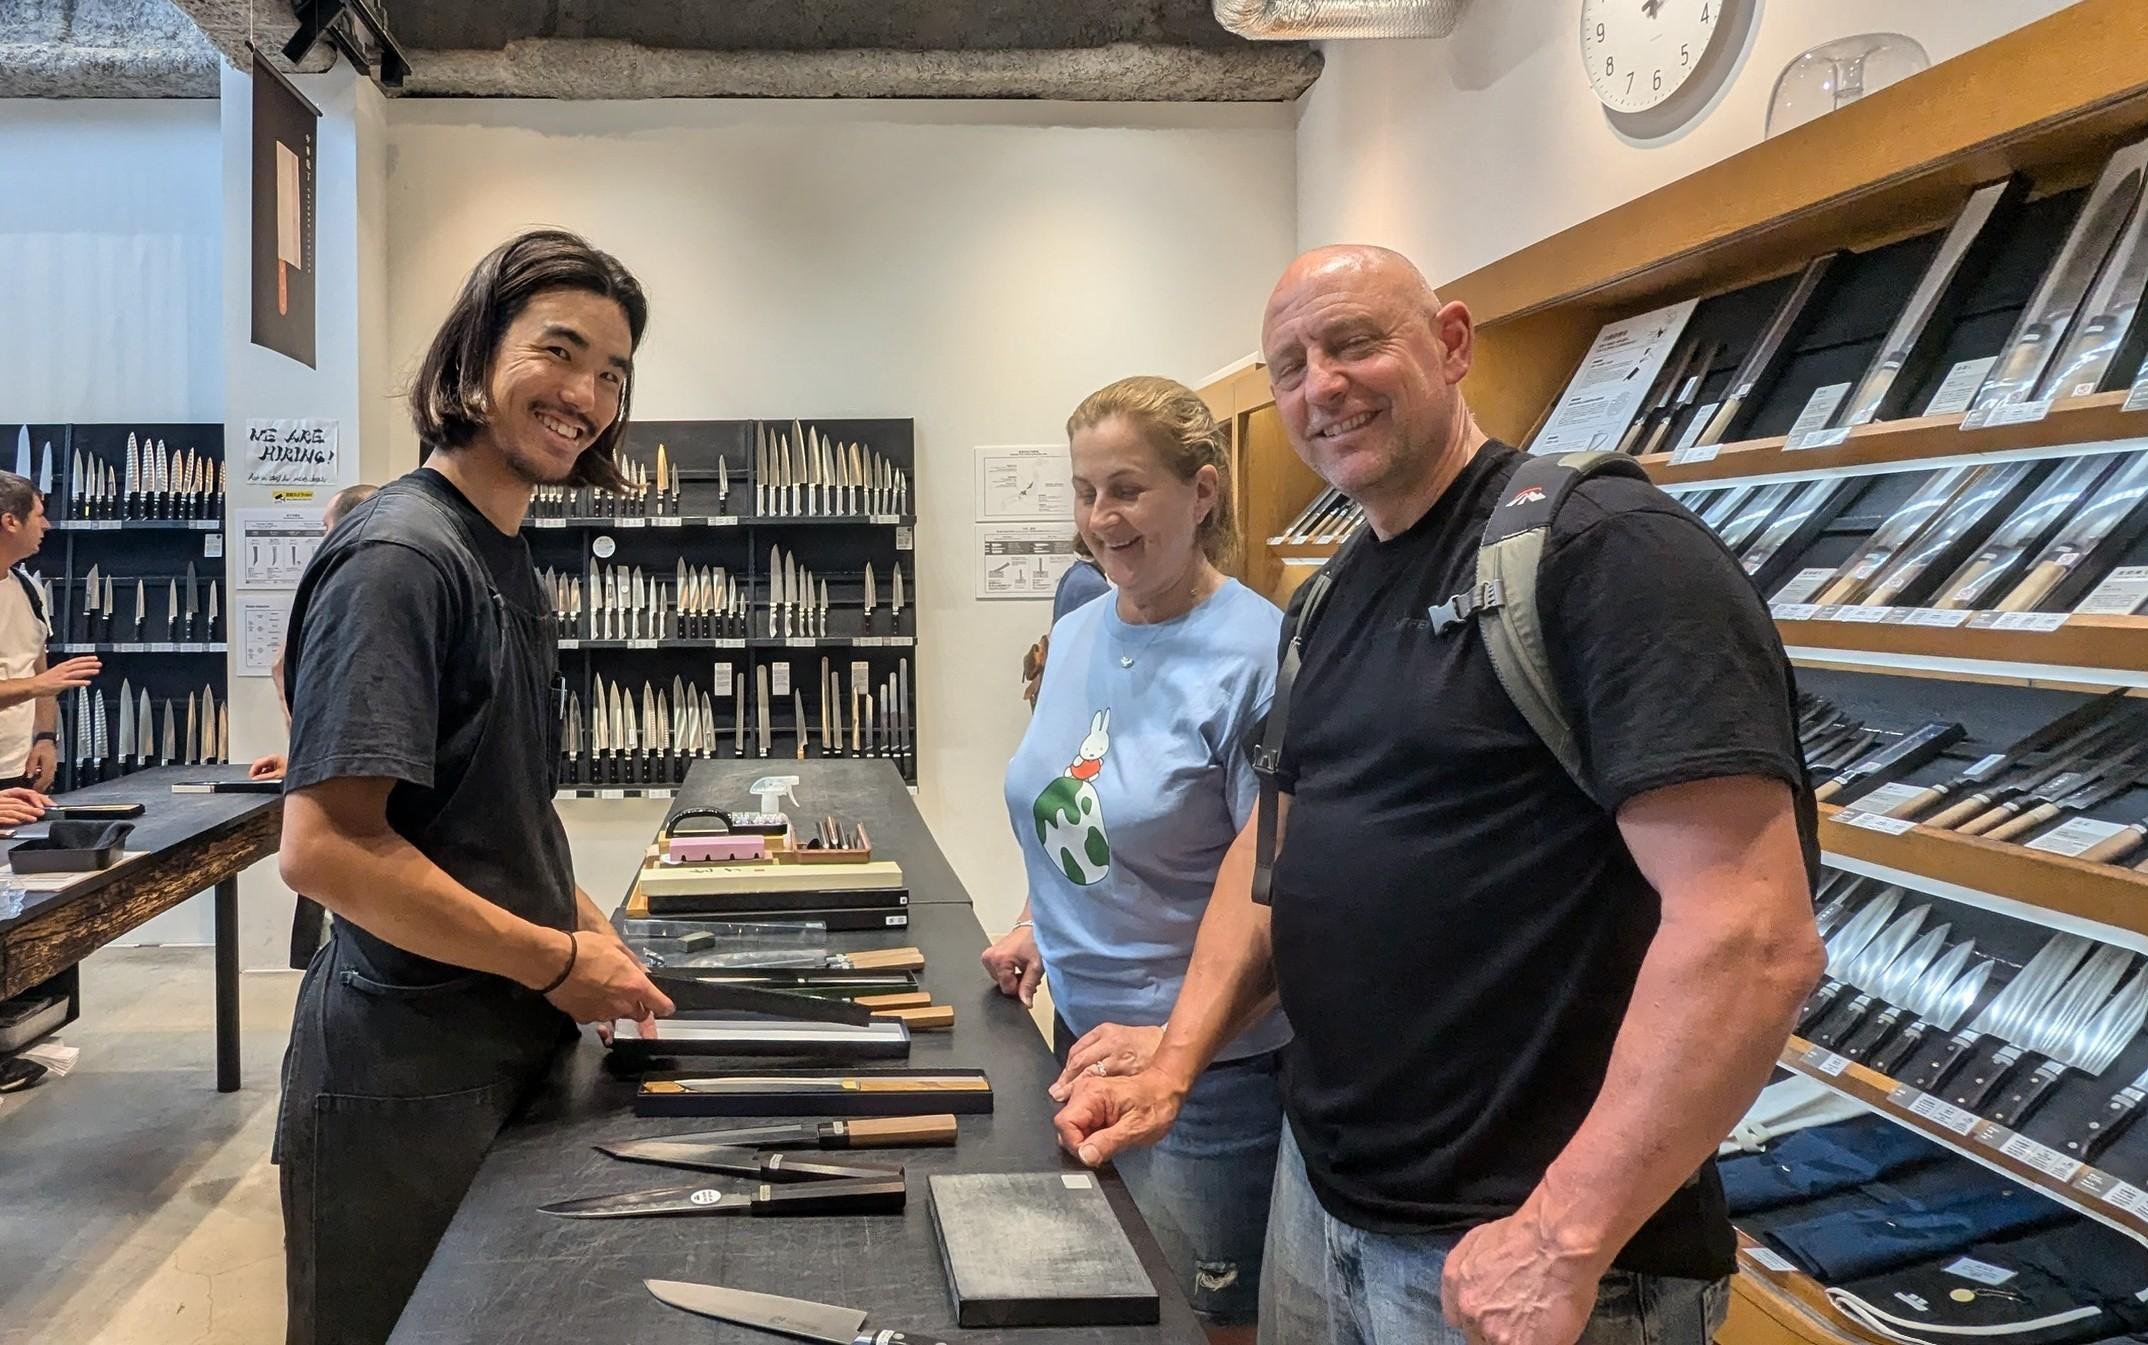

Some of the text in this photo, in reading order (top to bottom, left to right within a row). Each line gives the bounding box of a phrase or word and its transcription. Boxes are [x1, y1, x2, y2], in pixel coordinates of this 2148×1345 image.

[1700, 2, 1710, 24] 4
[1596, 22, 1605, 43] 9
[1680, 43, 1689, 66] 5
[1605, 56, 1614, 77] 8
[1626, 71, 1635, 95] 7
[1652, 69, 1662, 91] 6
[249, 427, 325, 444] WE ARE
[258, 445, 335, 464] HIRING!
